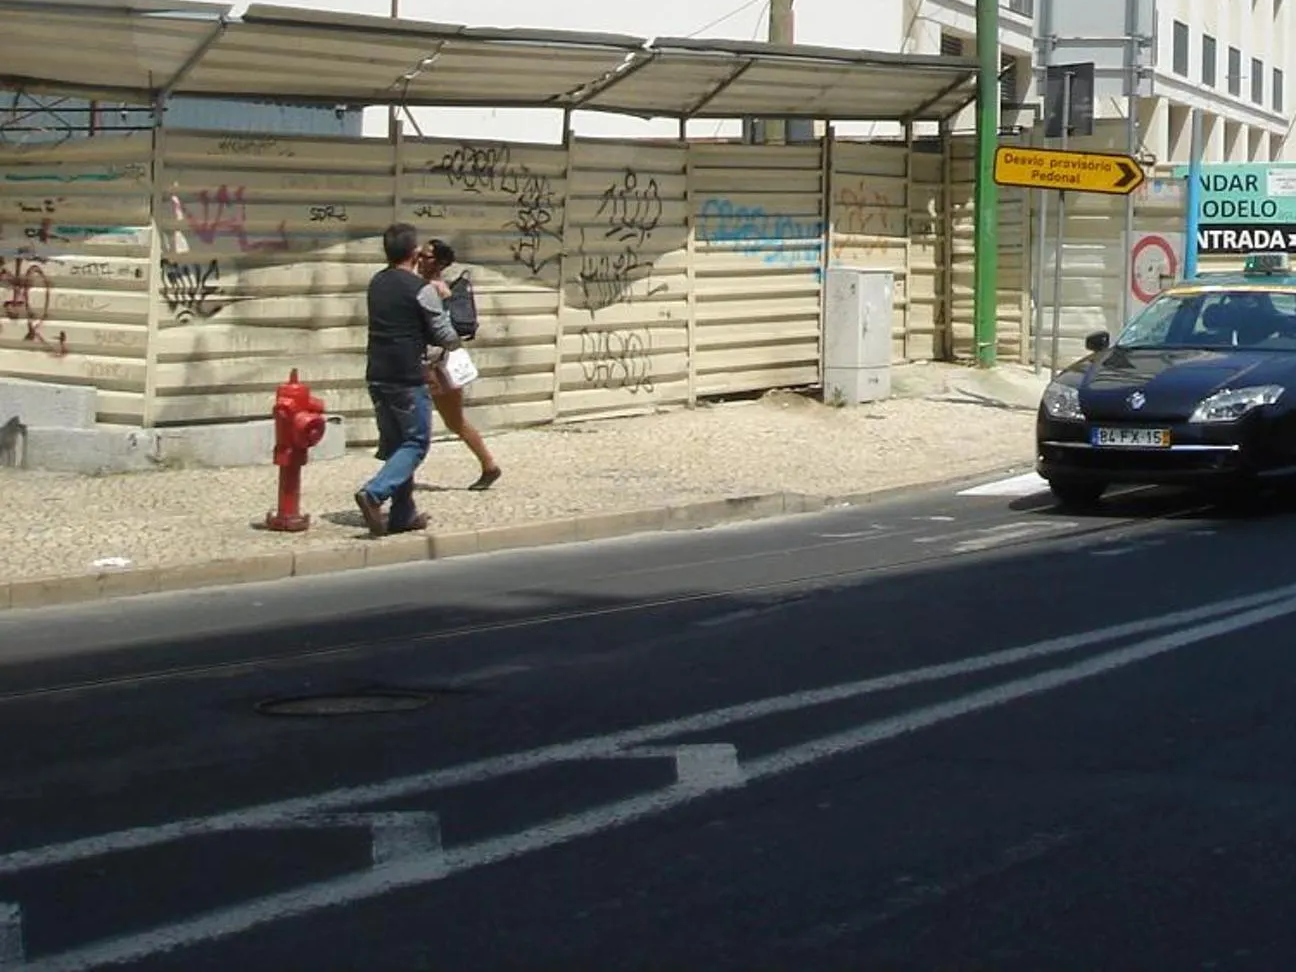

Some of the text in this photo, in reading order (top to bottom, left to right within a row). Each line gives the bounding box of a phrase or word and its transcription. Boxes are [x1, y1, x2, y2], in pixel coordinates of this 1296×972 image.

[1003, 152, 1045, 167] Desvio
[1031, 169, 1081, 184] Pedonal
[1198, 174, 1259, 192] NDAR
[1202, 199, 1278, 218] ODELO
[1197, 229, 1287, 249] NTRADA
